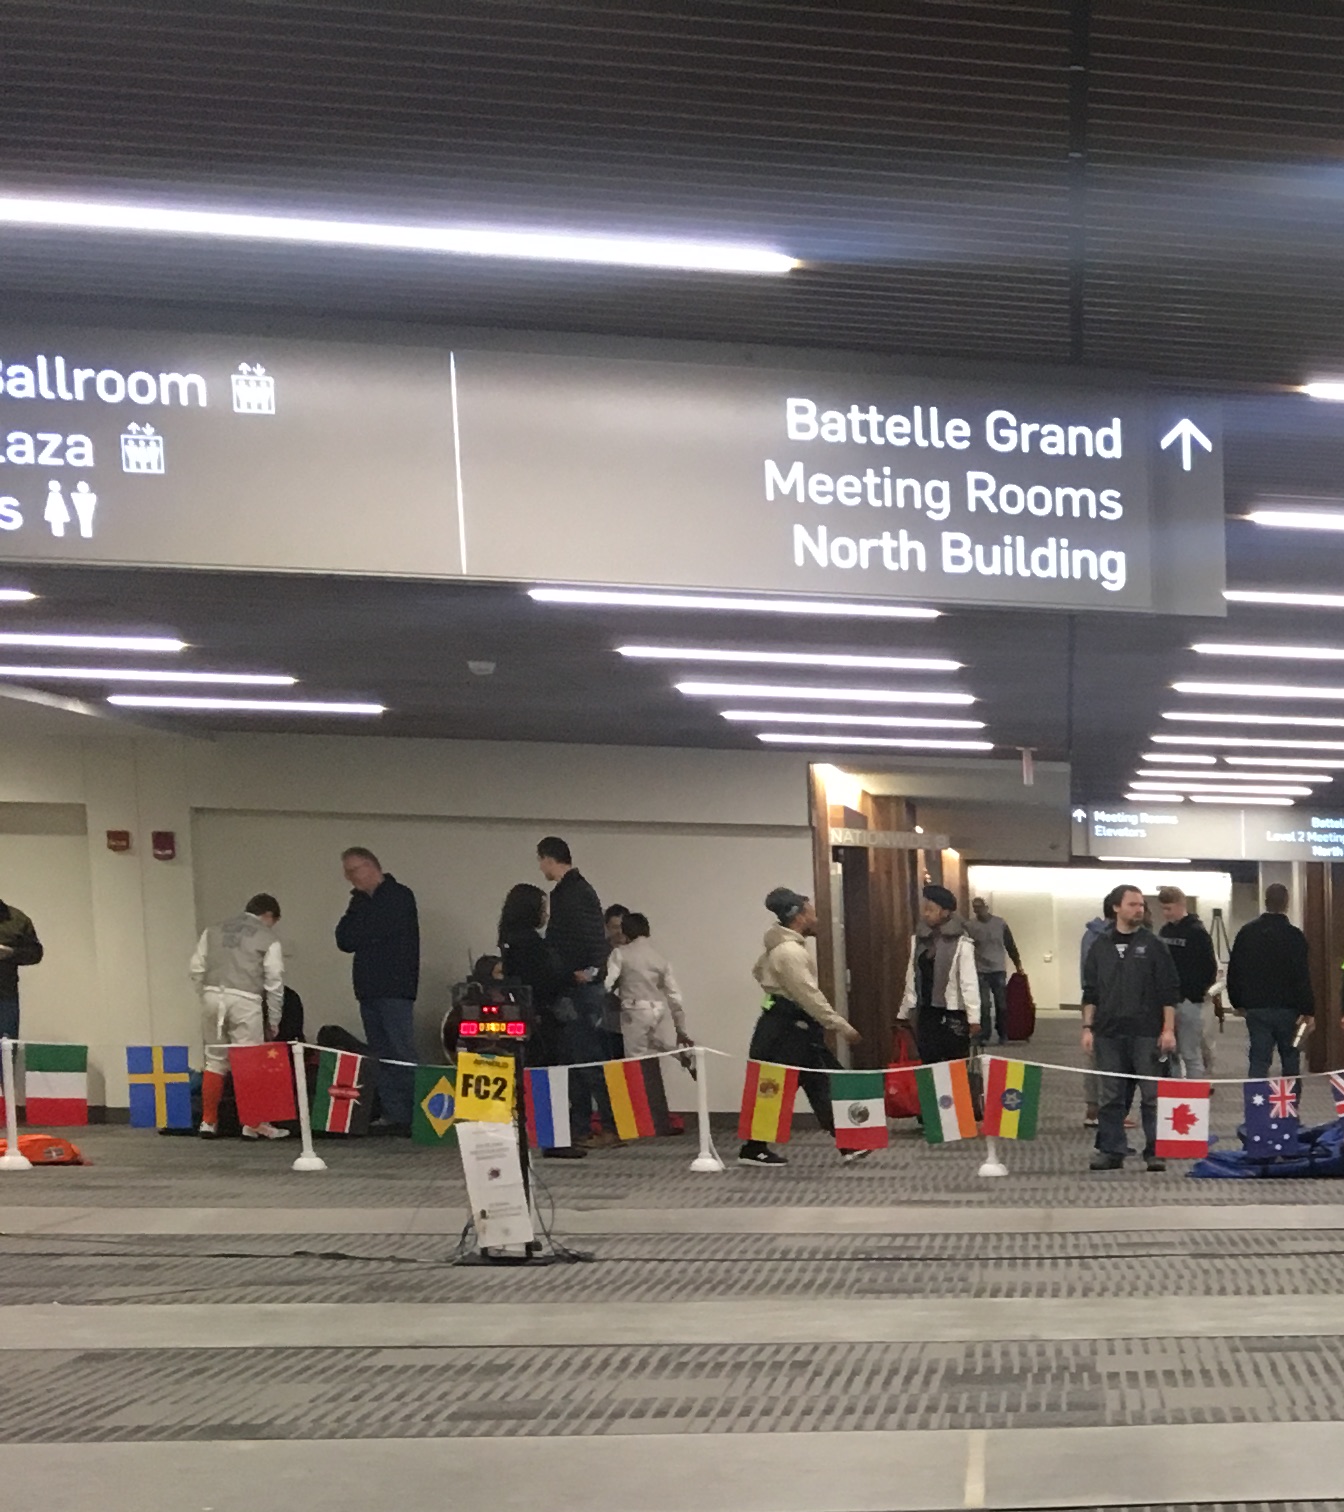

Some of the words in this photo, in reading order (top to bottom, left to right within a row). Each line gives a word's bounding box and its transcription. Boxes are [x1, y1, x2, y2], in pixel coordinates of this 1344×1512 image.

[0, 354, 207, 408] allroom
[786, 397, 971, 450] Battelle
[984, 410, 1123, 459] Grand
[763, 458, 951, 521] Meeting
[965, 470, 1124, 520] Rooms
[792, 523, 927, 572] North
[941, 531, 1127, 592] Building
[1093, 810, 1138, 825] Meeting
[1139, 812, 1179, 825] Rooms
[831, 828, 932, 848] NATIONWIDE
[1094, 824, 1147, 838] Elevators
[1266, 830, 1296, 843] Level
[1298, 831, 1305, 843] 2
[1312, 845, 1343, 857] North
[461, 1073, 508, 1102] FC2
